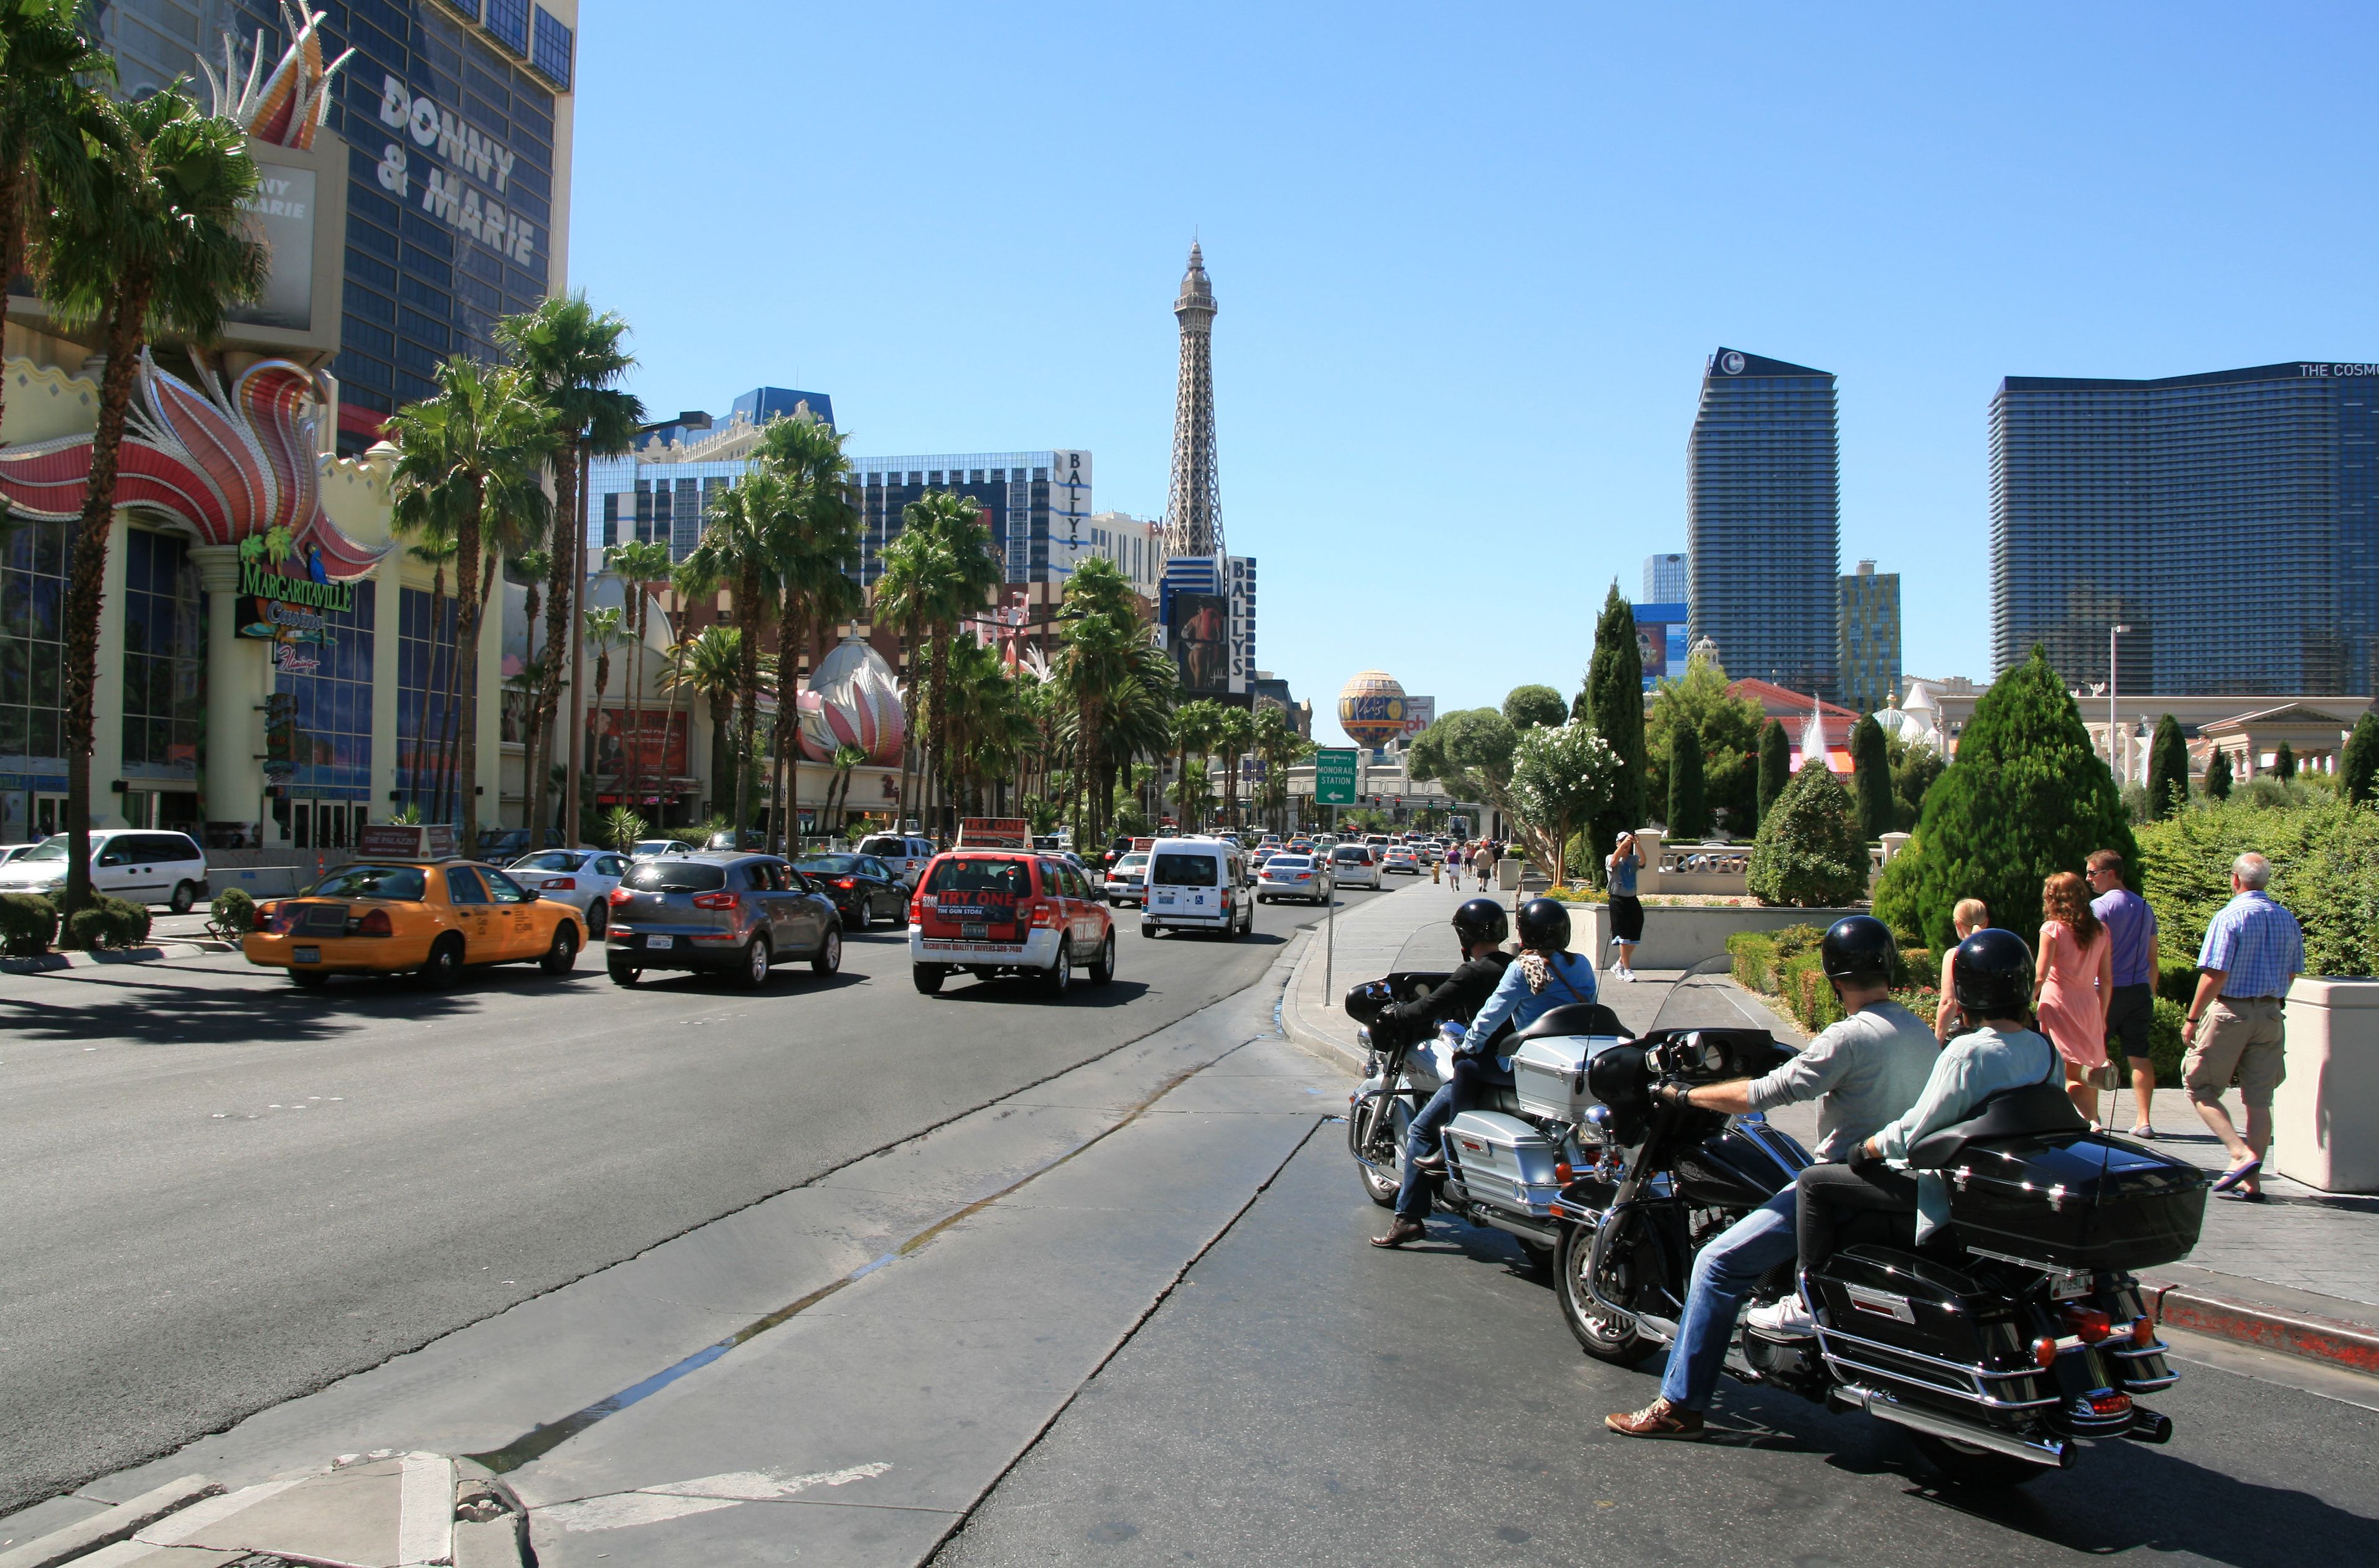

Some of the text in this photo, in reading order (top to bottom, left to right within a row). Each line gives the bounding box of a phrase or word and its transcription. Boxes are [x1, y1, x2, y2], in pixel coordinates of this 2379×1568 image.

[380, 74, 515, 194] DONNY
[378, 144, 533, 268] & MARIE
[2299, 365, 2328, 376] THE
[1068, 454, 1082, 550] BALLYS
[242, 561, 353, 613] MARGARITAVILLE
[267, 600, 325, 630] Casino
[1232, 561, 1246, 676] BALLYS
[279, 645, 321, 676] Flamingo
[1356, 696, 1383, 723] Paris
[1317, 766, 1354, 775] MONORAIL
[1321, 777, 1350, 785] STATION
[965, 819, 1024, 830] TRY ONE
[381, 837, 418, 846] PALAZZO
[940, 892, 1016, 906] TRY ONE
[1075, 923, 1095, 940] TRY ONE
